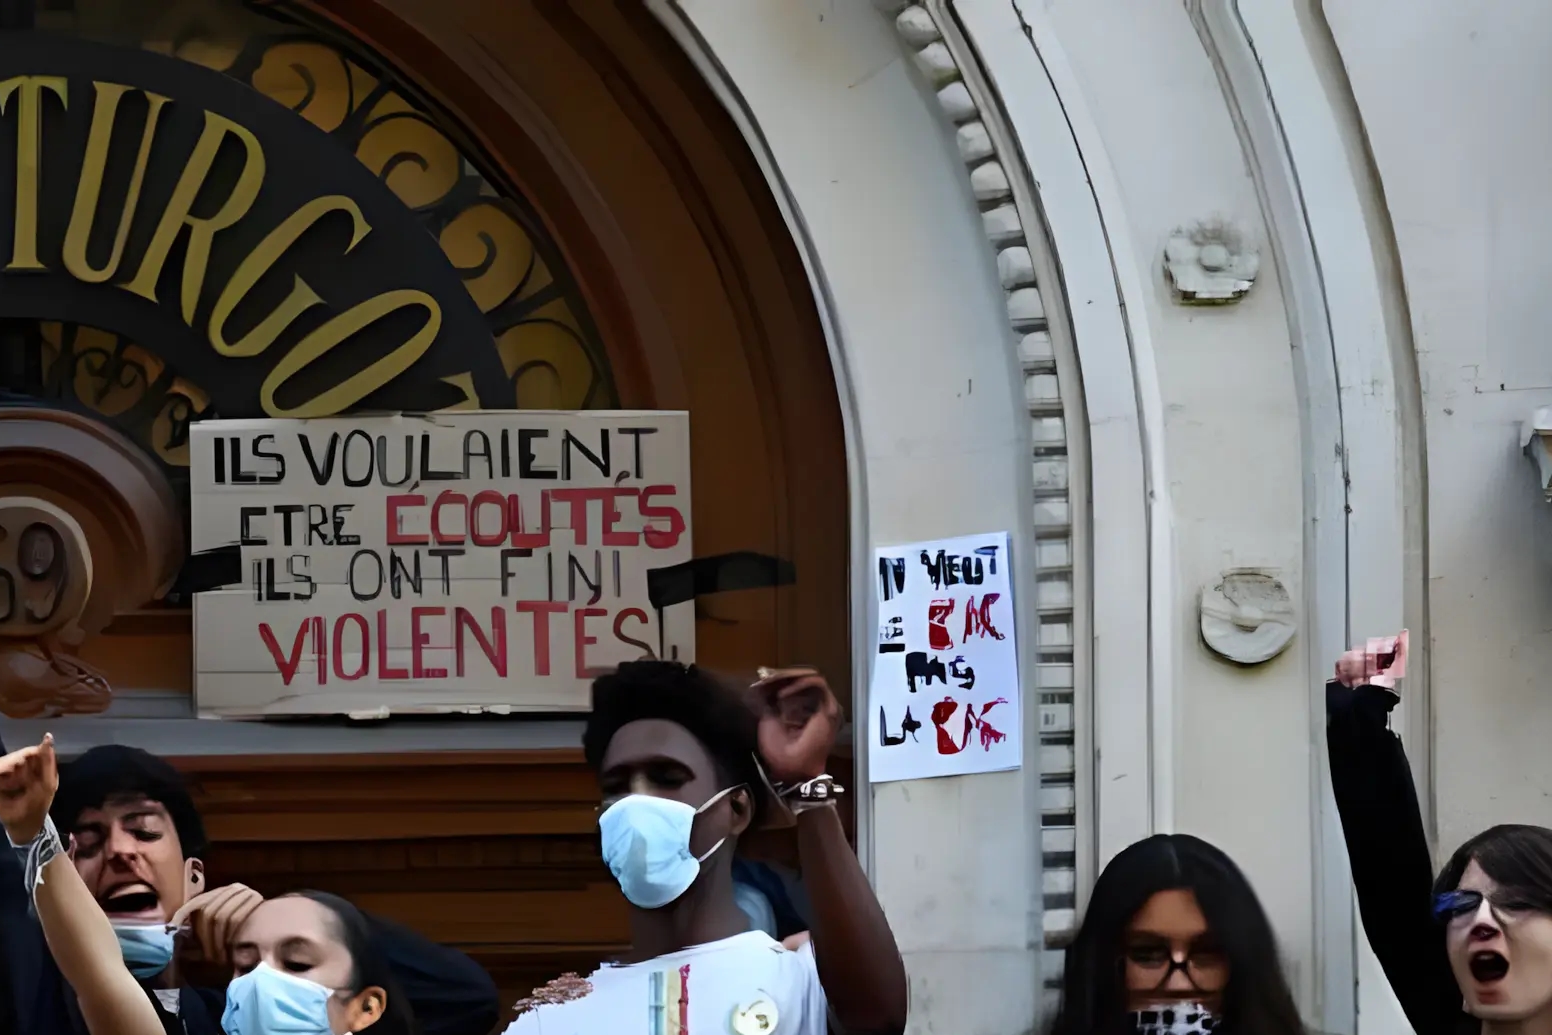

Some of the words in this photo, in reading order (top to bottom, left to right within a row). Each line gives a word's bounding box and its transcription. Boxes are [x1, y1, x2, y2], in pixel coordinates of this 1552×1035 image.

[213, 433, 286, 484] ILS
[298, 427, 658, 487] VOULAIENT
[252, 553, 316, 603] ILS
[349, 547, 466, 601] ONT
[500, 548, 621, 603] FINI
